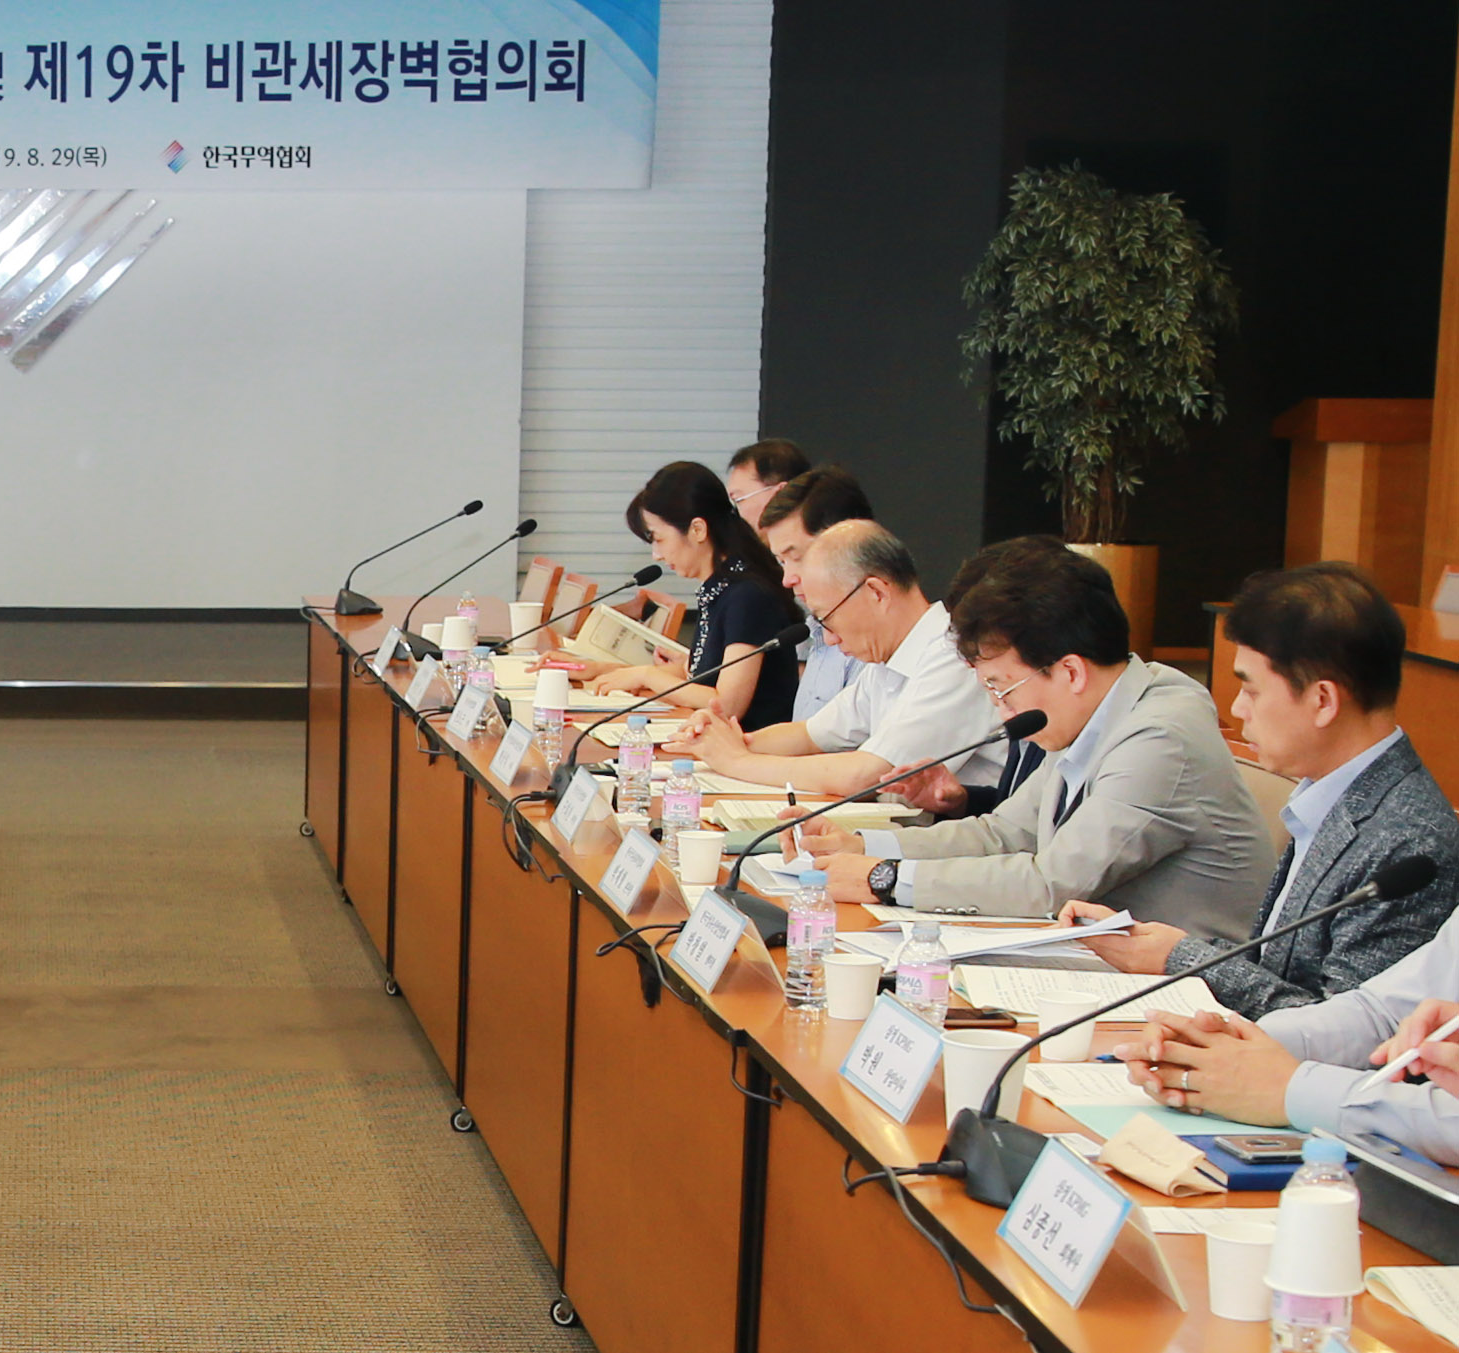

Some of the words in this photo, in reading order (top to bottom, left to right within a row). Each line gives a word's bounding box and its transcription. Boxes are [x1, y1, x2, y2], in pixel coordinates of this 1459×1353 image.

[23, 40, 186, 104] 제19차
[205, 38, 587, 104] 비관세장벽협의회
[27, 147, 45, 167] 8.
[51, 146, 107, 168] 29(목)
[202, 145, 312, 169] 한국무역협회
